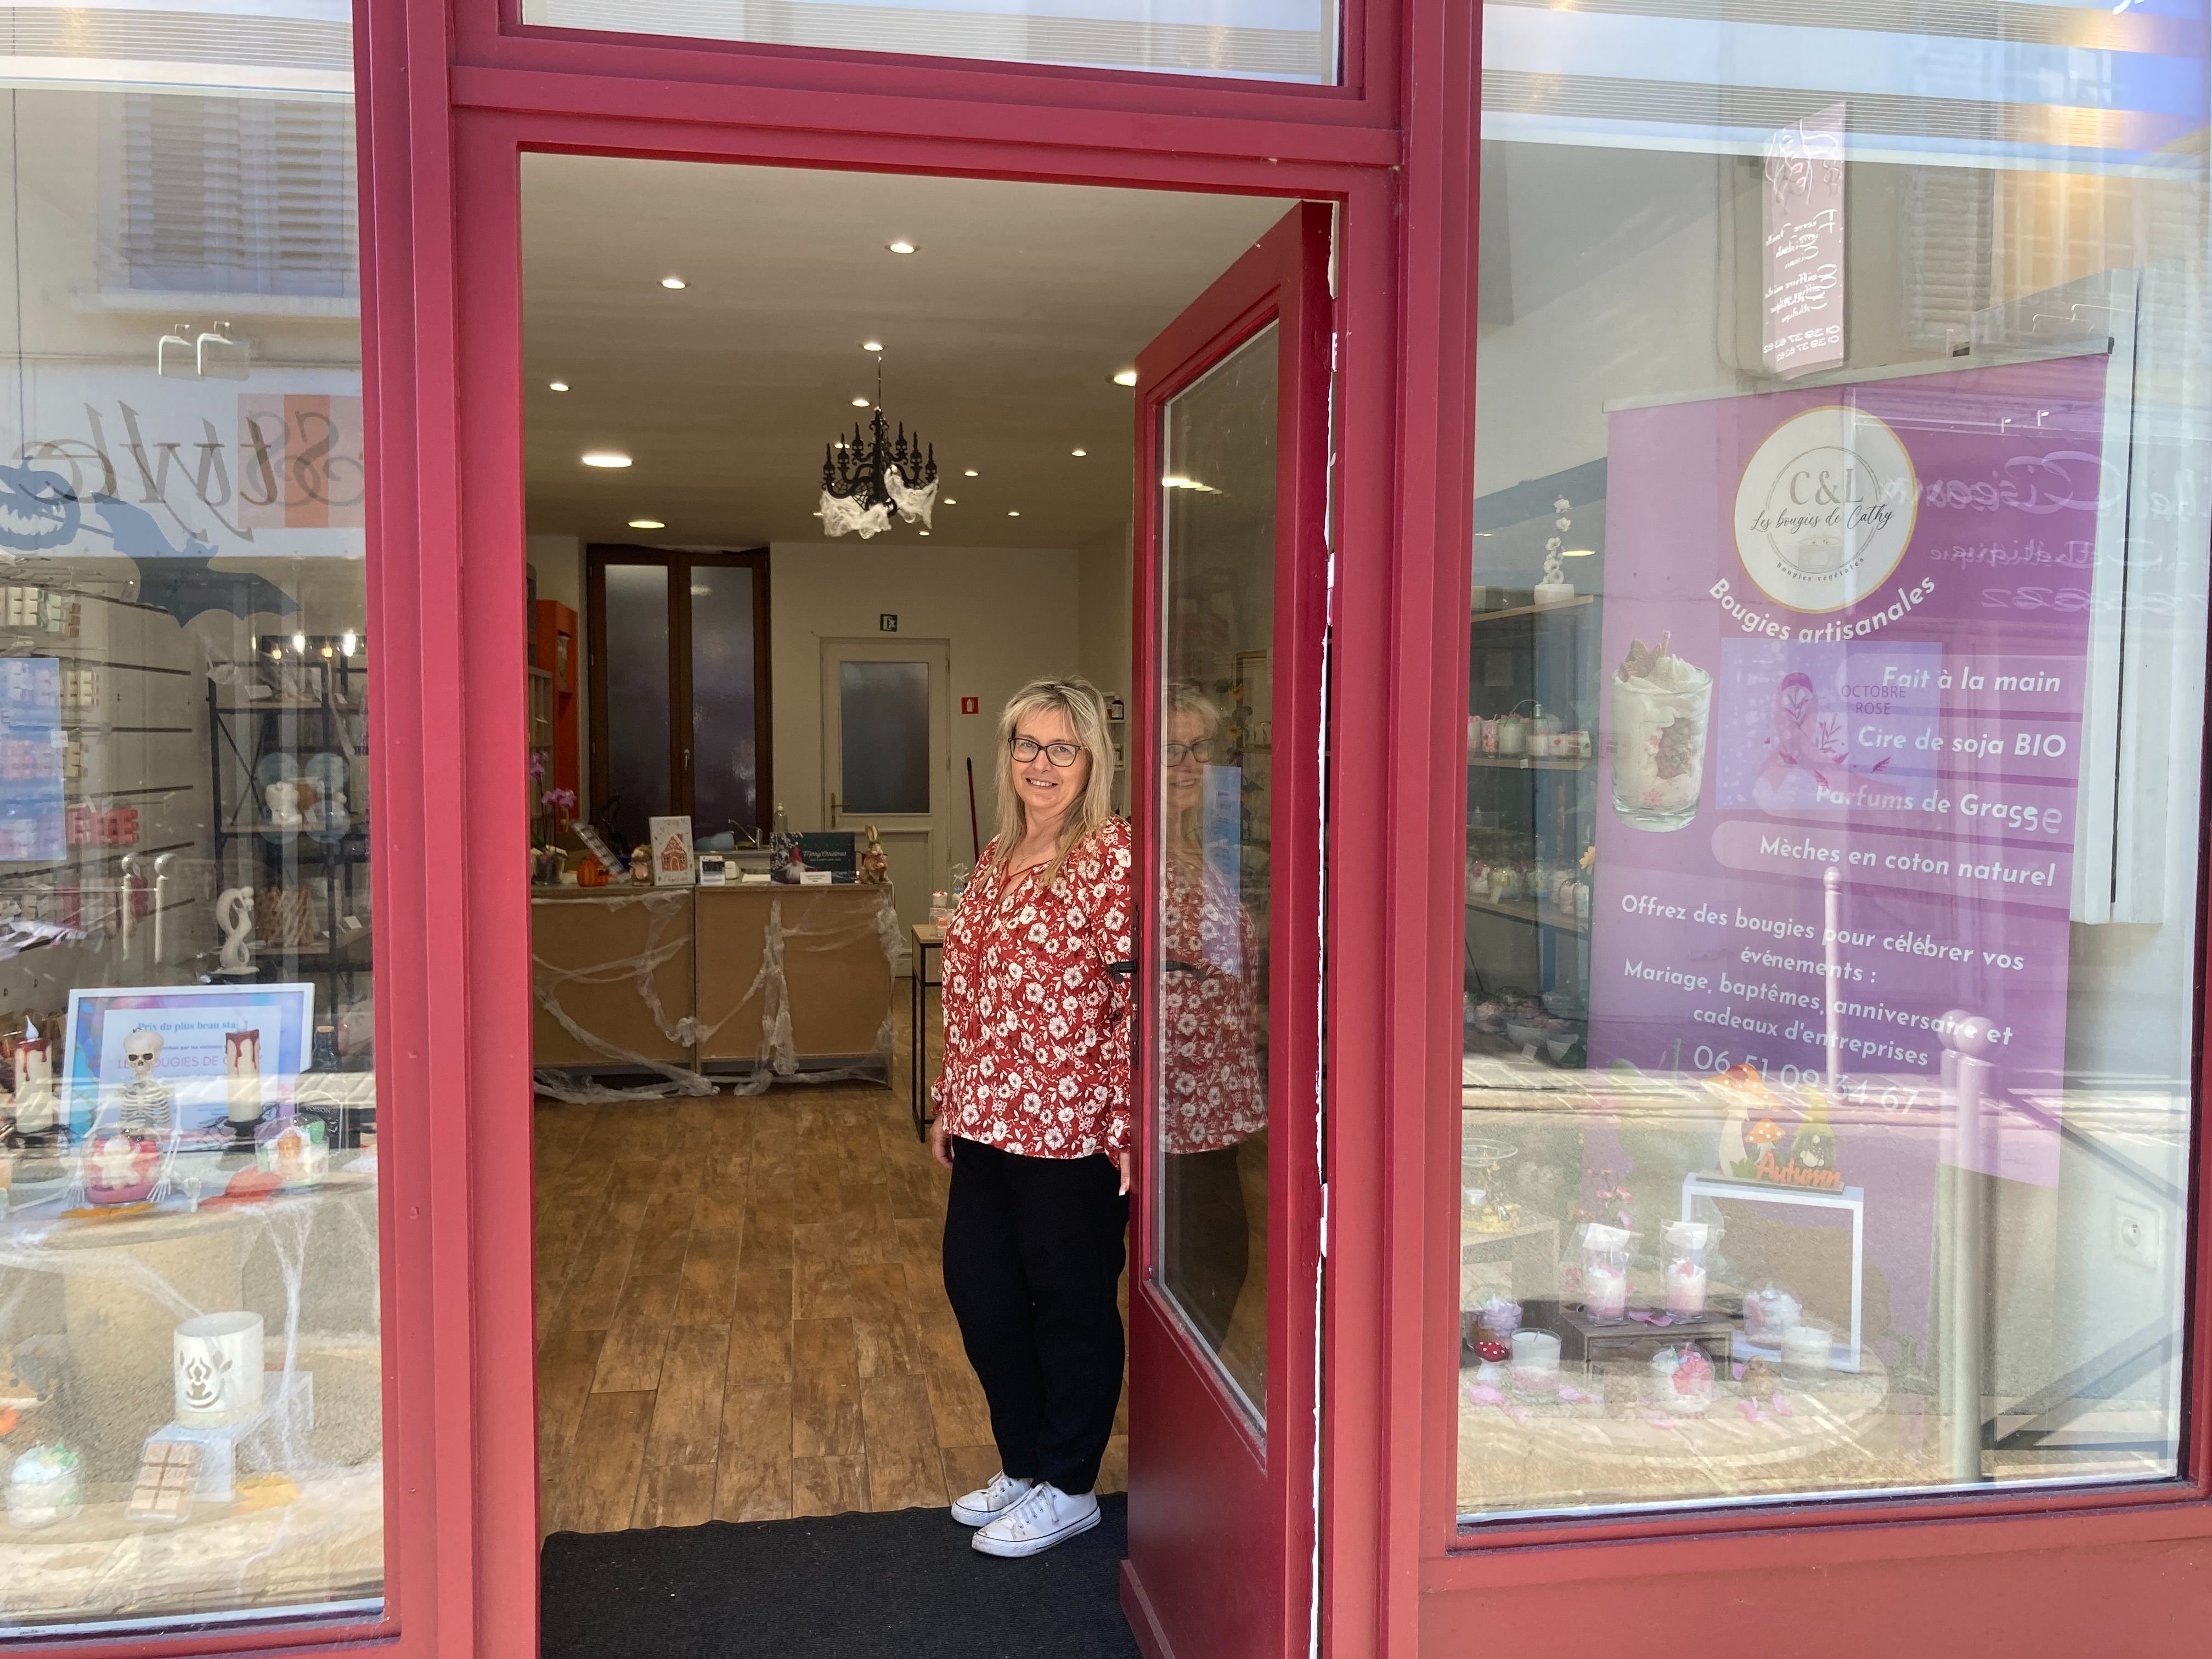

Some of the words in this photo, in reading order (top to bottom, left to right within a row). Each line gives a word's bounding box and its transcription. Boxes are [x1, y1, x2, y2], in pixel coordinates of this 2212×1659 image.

[1790, 469, 1864, 505] C&L
[1750, 510, 1771, 532] Les
[1776, 509, 1820, 534] bougies
[1825, 507, 1843, 526] de
[1847, 504, 1894, 530] Cathy
[1709, 578, 1791, 640] Bougies
[1798, 575, 1936, 644] artisanales
[1841, 685, 1905, 698] OCTOBRE
[1882, 667, 1931, 689] Fait
[1938, 669, 1953, 689] à
[1961, 667, 1985, 690] la
[1994, 671, 2061, 692] main
[1856, 702, 1891, 715] ROSE
[1858, 725, 1906, 749] Cire
[1915, 728, 1944, 751] de
[1951, 733, 2004, 759] soja
[2015, 733, 2066, 758] BIO
[1922, 790, 1951, 812] de
[1760, 835, 1840, 863] Mèches
[1849, 851, 1876, 866] en
[1885, 853, 1949, 875] coton
[1958, 862, 2056, 887] naturel
[1621, 894, 1686, 920] Offrez
[1694, 903, 1728, 926] des
[1735, 907, 1815, 939] bougies
[1821, 928, 1876, 947] pour
[1883, 931, 1974, 962] célébrer
[1983, 951, 2024, 970] vos
[1741, 946, 1863, 981] événements
[1624, 957, 1712, 994] Mariage,
[1719, 972, 1824, 1015] baptêmes,
[1833, 1000, 1978, 1039] anniversaire
[1987, 1026, 2013, 1045] et
[160, 1022, 172, 1031] du
[174, 1022, 194, 1032] plus
[198, 1021, 219, 1030] beau
[1694, 1007, 1779, 1036] cadeaux
[1785, 1020, 1928, 1066] d'entreprises
[150, 1056, 199, 1068] OUGIES
[203, 1056, 218, 1066] DE
[1694, 1045, 1731, 1074] 06
[1756, 1149, 1842, 1189] Autumn
